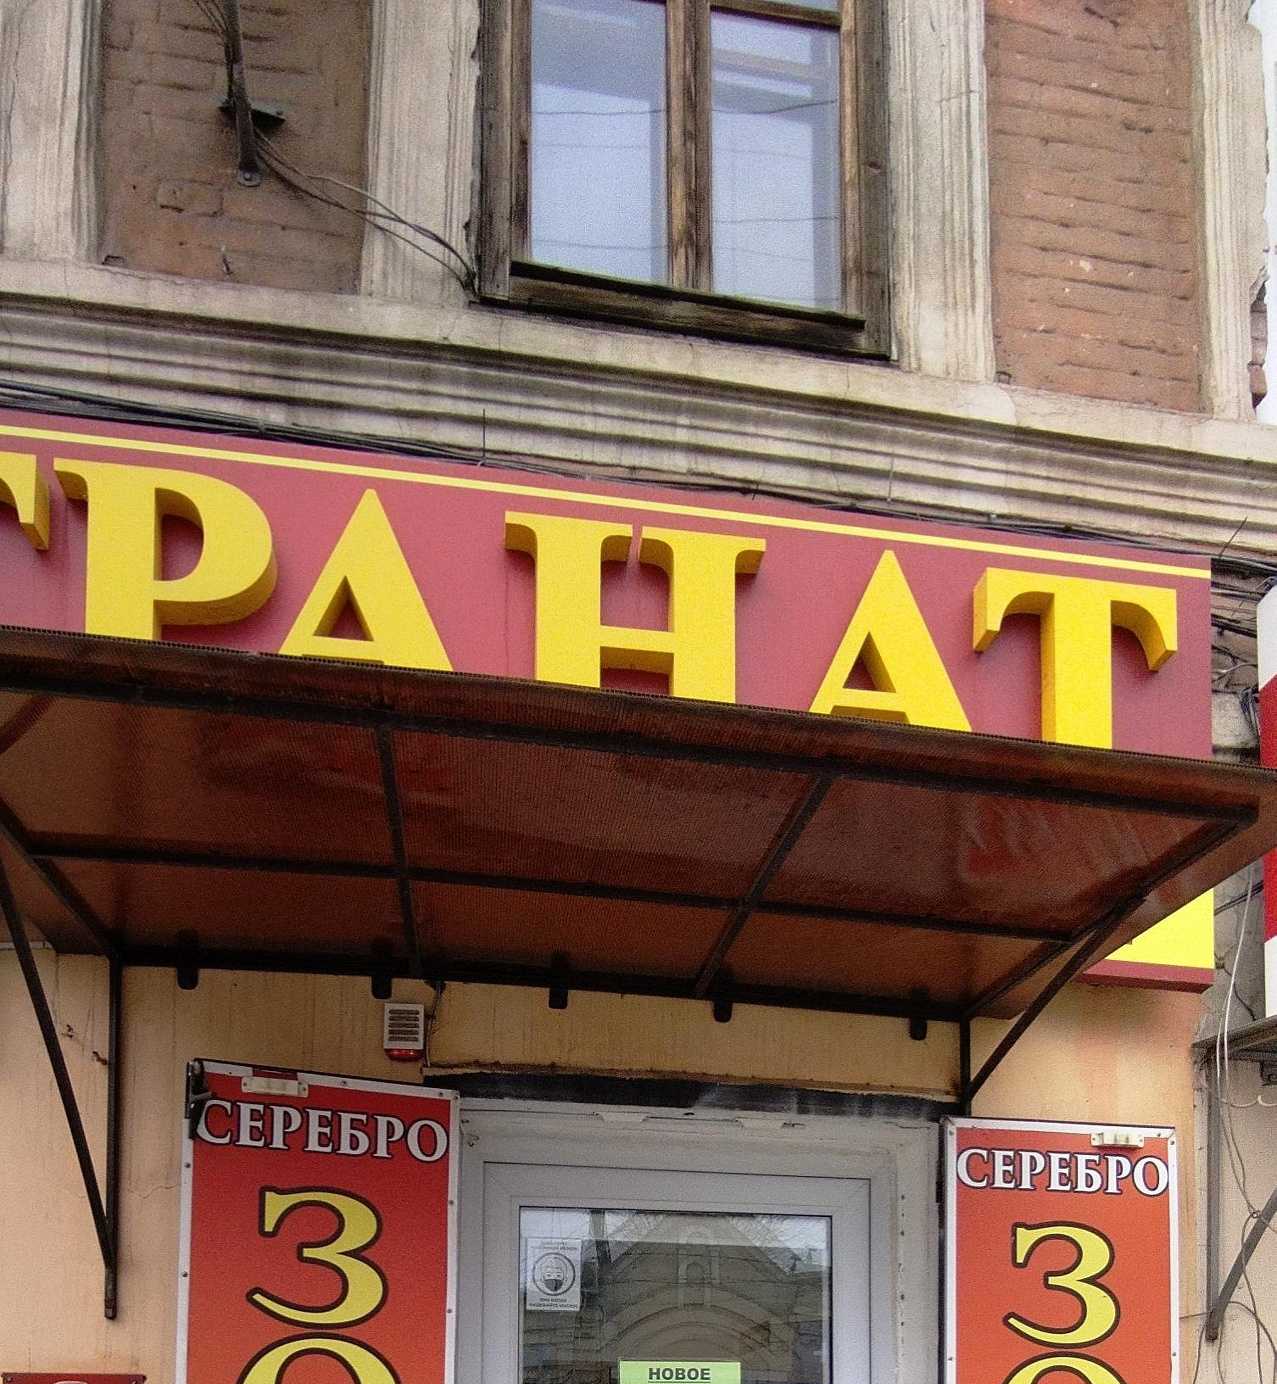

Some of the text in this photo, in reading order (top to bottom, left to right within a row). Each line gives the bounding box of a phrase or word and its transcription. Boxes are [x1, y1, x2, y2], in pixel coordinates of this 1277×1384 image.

[0, 453, 1178, 749] РАНАТ
[197, 1100, 449, 1163] СЕРЕБРО
[956, 1147, 1170, 1198] СЕРЕБРО
[648, 1367, 711, 1381] НОВОЕ
